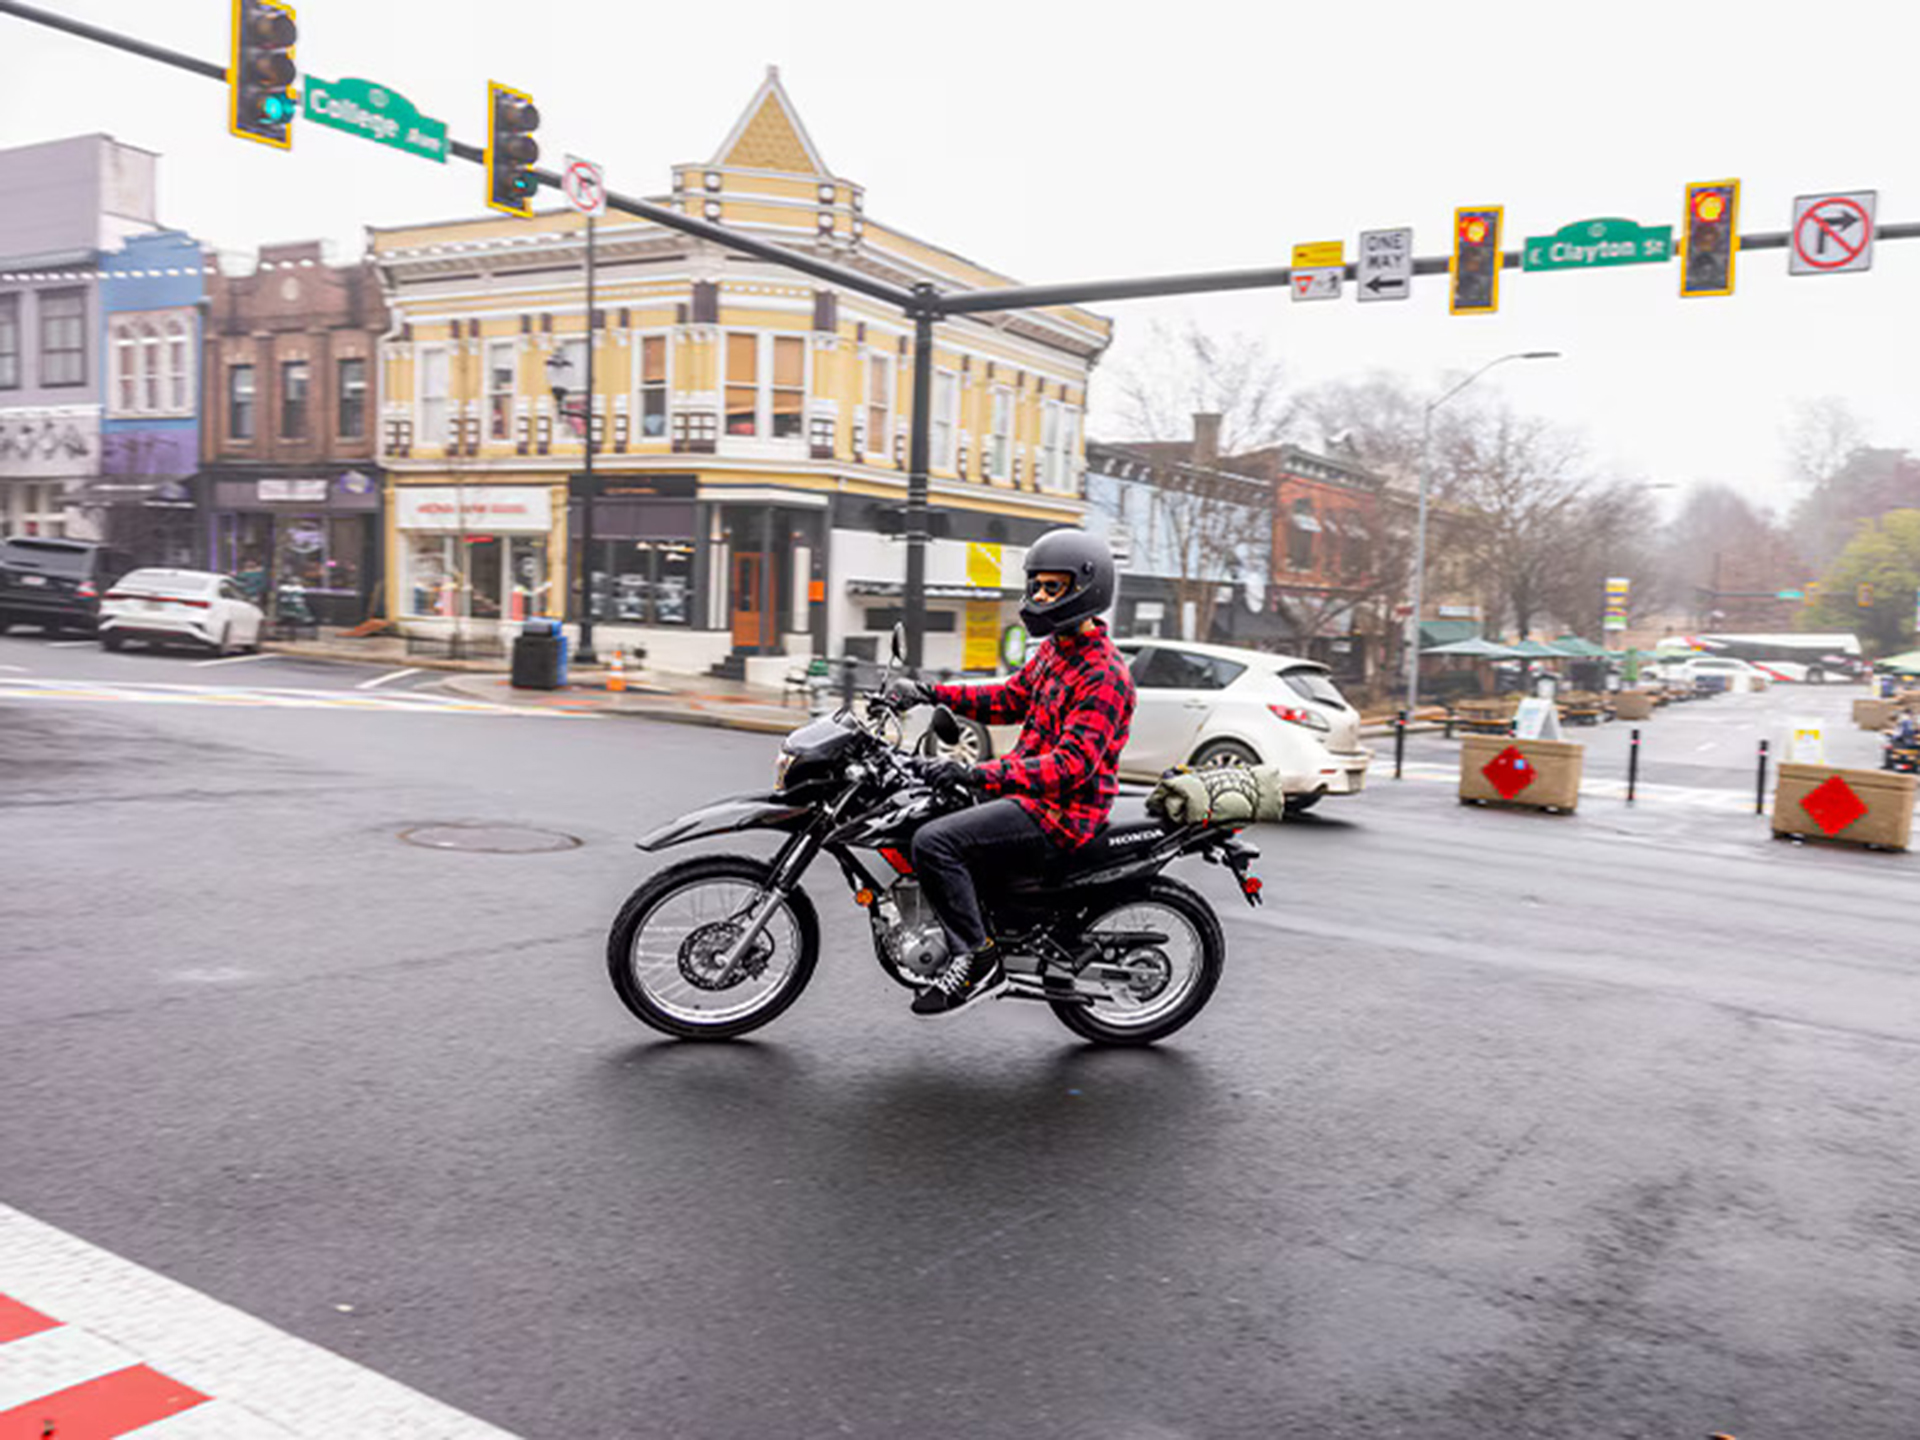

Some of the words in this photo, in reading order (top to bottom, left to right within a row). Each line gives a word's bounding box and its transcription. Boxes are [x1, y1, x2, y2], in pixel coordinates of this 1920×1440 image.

[309, 88, 400, 139] College
[1366, 232, 1403, 252] ONE
[1366, 253, 1404, 271] WAY
[1549, 241, 1637, 264] Clayton
[1109, 829, 1165, 846] HONDA
